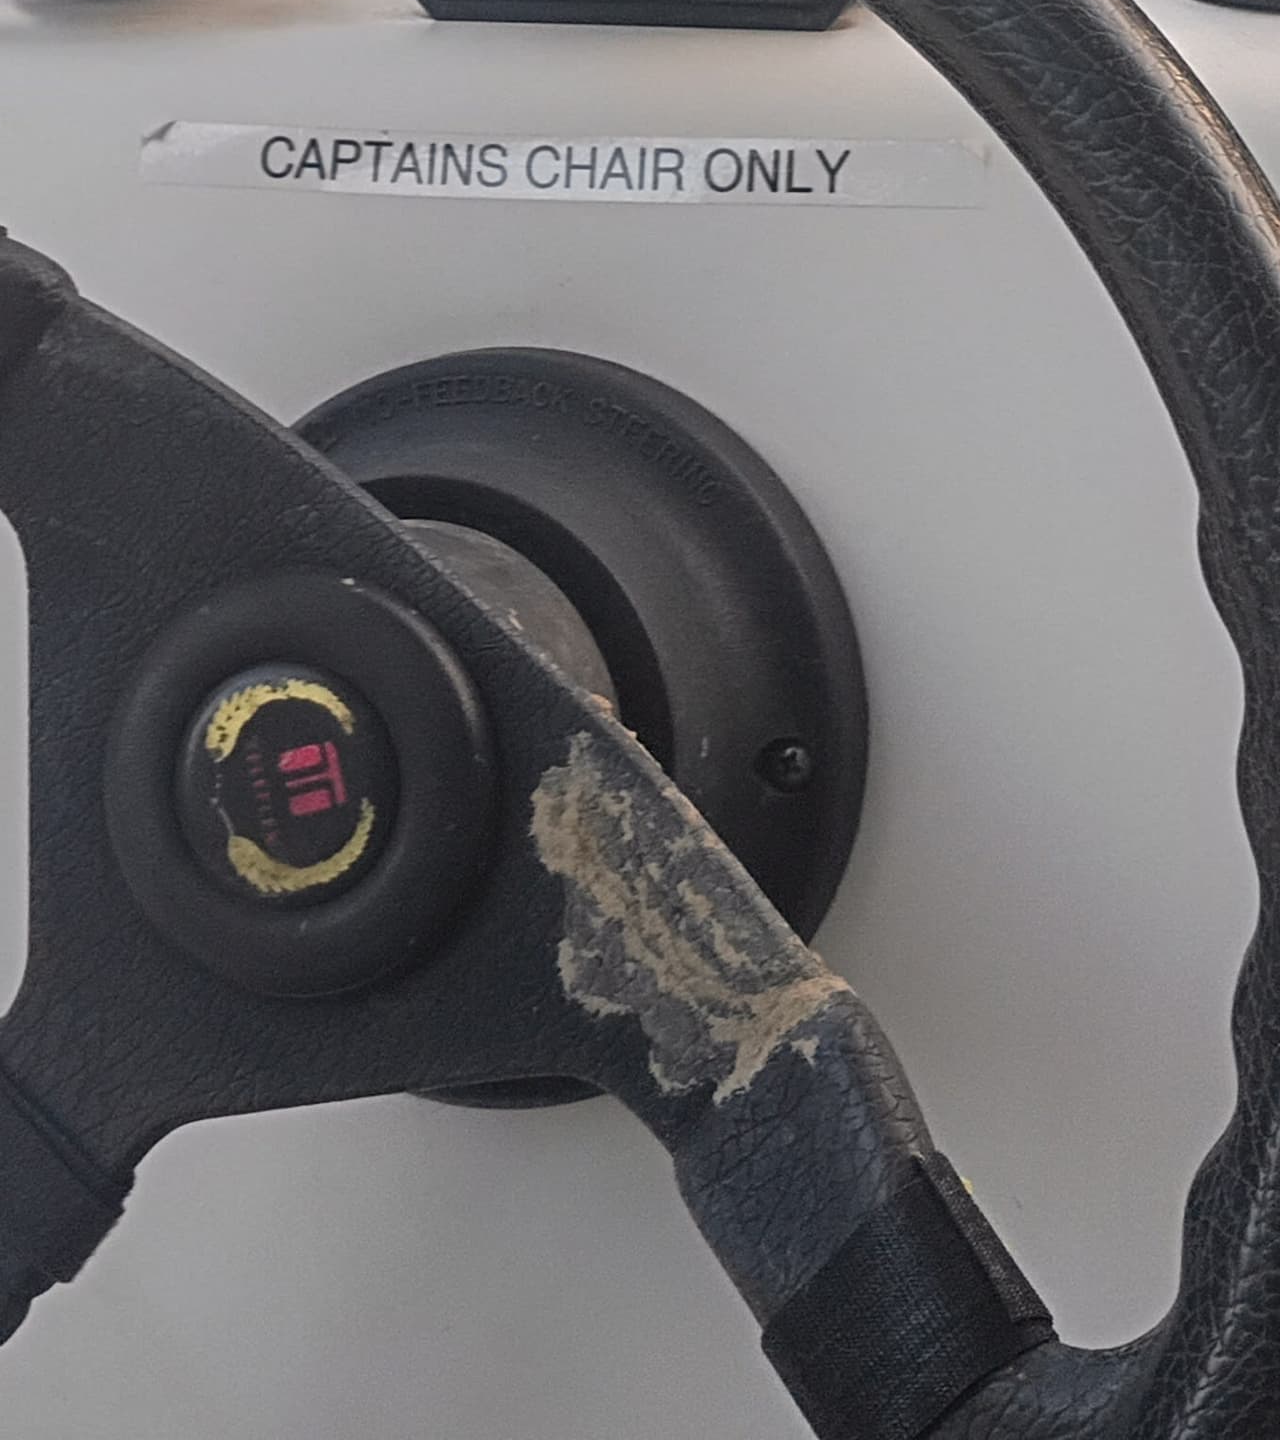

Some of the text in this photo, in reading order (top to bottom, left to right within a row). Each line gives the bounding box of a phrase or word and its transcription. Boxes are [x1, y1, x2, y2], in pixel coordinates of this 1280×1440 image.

[260, 136, 851, 193] CAPTAINS CHAIR ONLY
